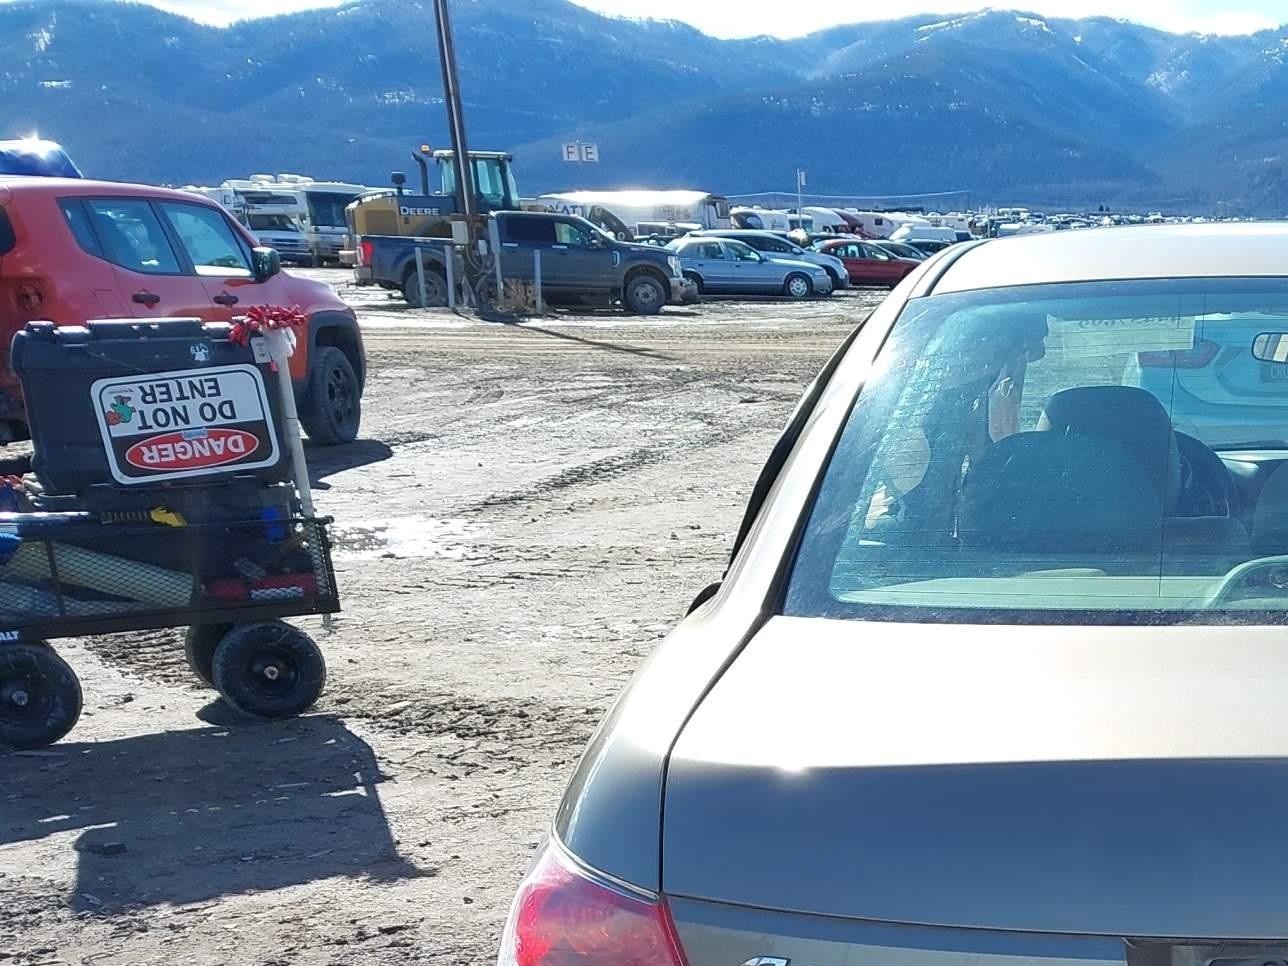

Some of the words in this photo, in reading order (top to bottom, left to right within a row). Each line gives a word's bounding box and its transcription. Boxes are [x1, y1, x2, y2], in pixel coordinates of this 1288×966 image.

[566, 145, 575, 160] F
[585, 146, 595, 160] E
[400, 206, 440, 216] DEERE
[139, 377, 222, 405] ENTER
[137, 404, 191, 431] NOT
[199, 399, 237, 422] DO
[140, 435, 245, 464] DANGER
